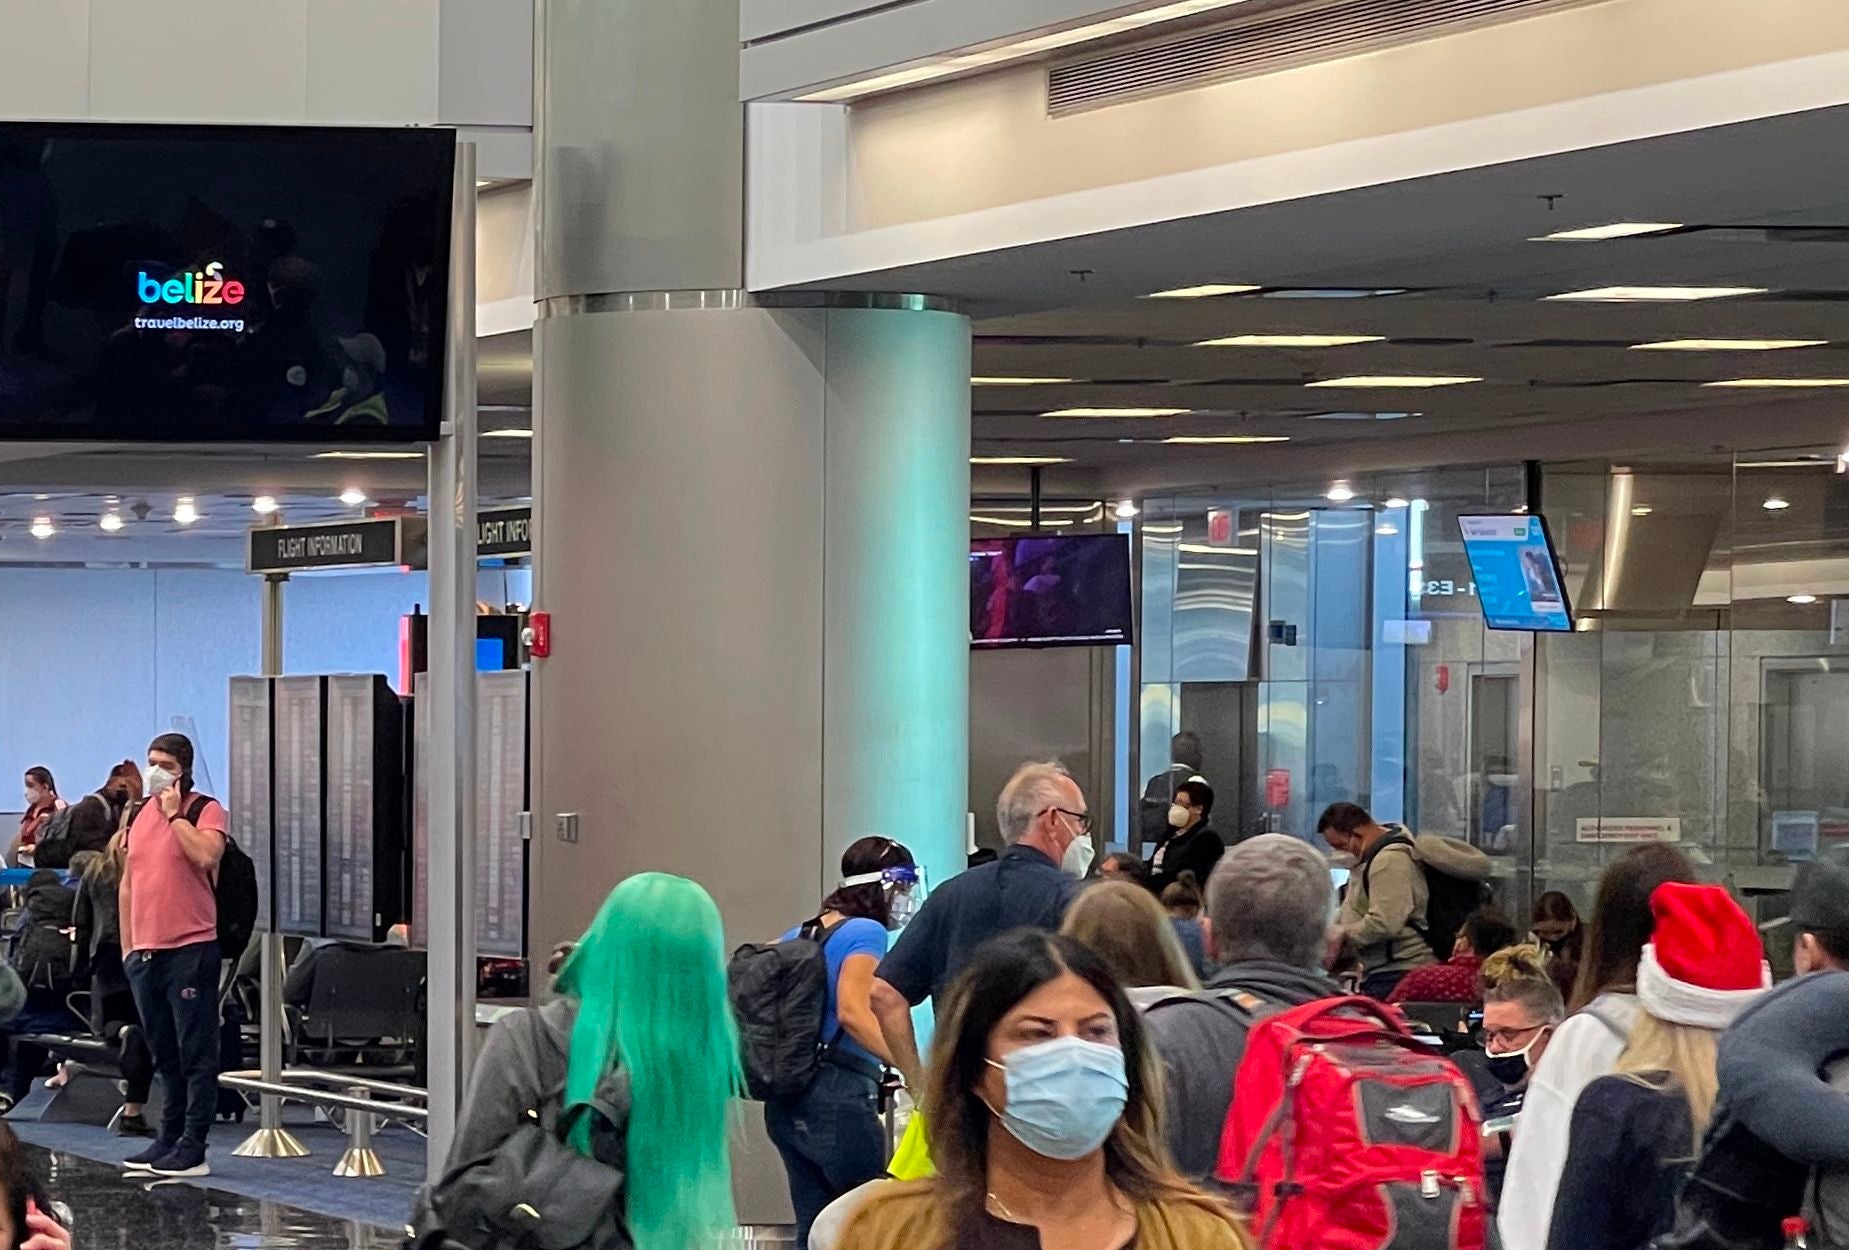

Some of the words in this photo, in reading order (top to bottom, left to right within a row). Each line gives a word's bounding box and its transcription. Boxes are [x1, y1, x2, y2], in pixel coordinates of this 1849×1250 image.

[138, 266, 245, 304] belize
[134, 316, 245, 333] travelbelize.org
[278, 536, 306, 559] FLIGHT
[307, 533, 363, 557] INFORMATION
